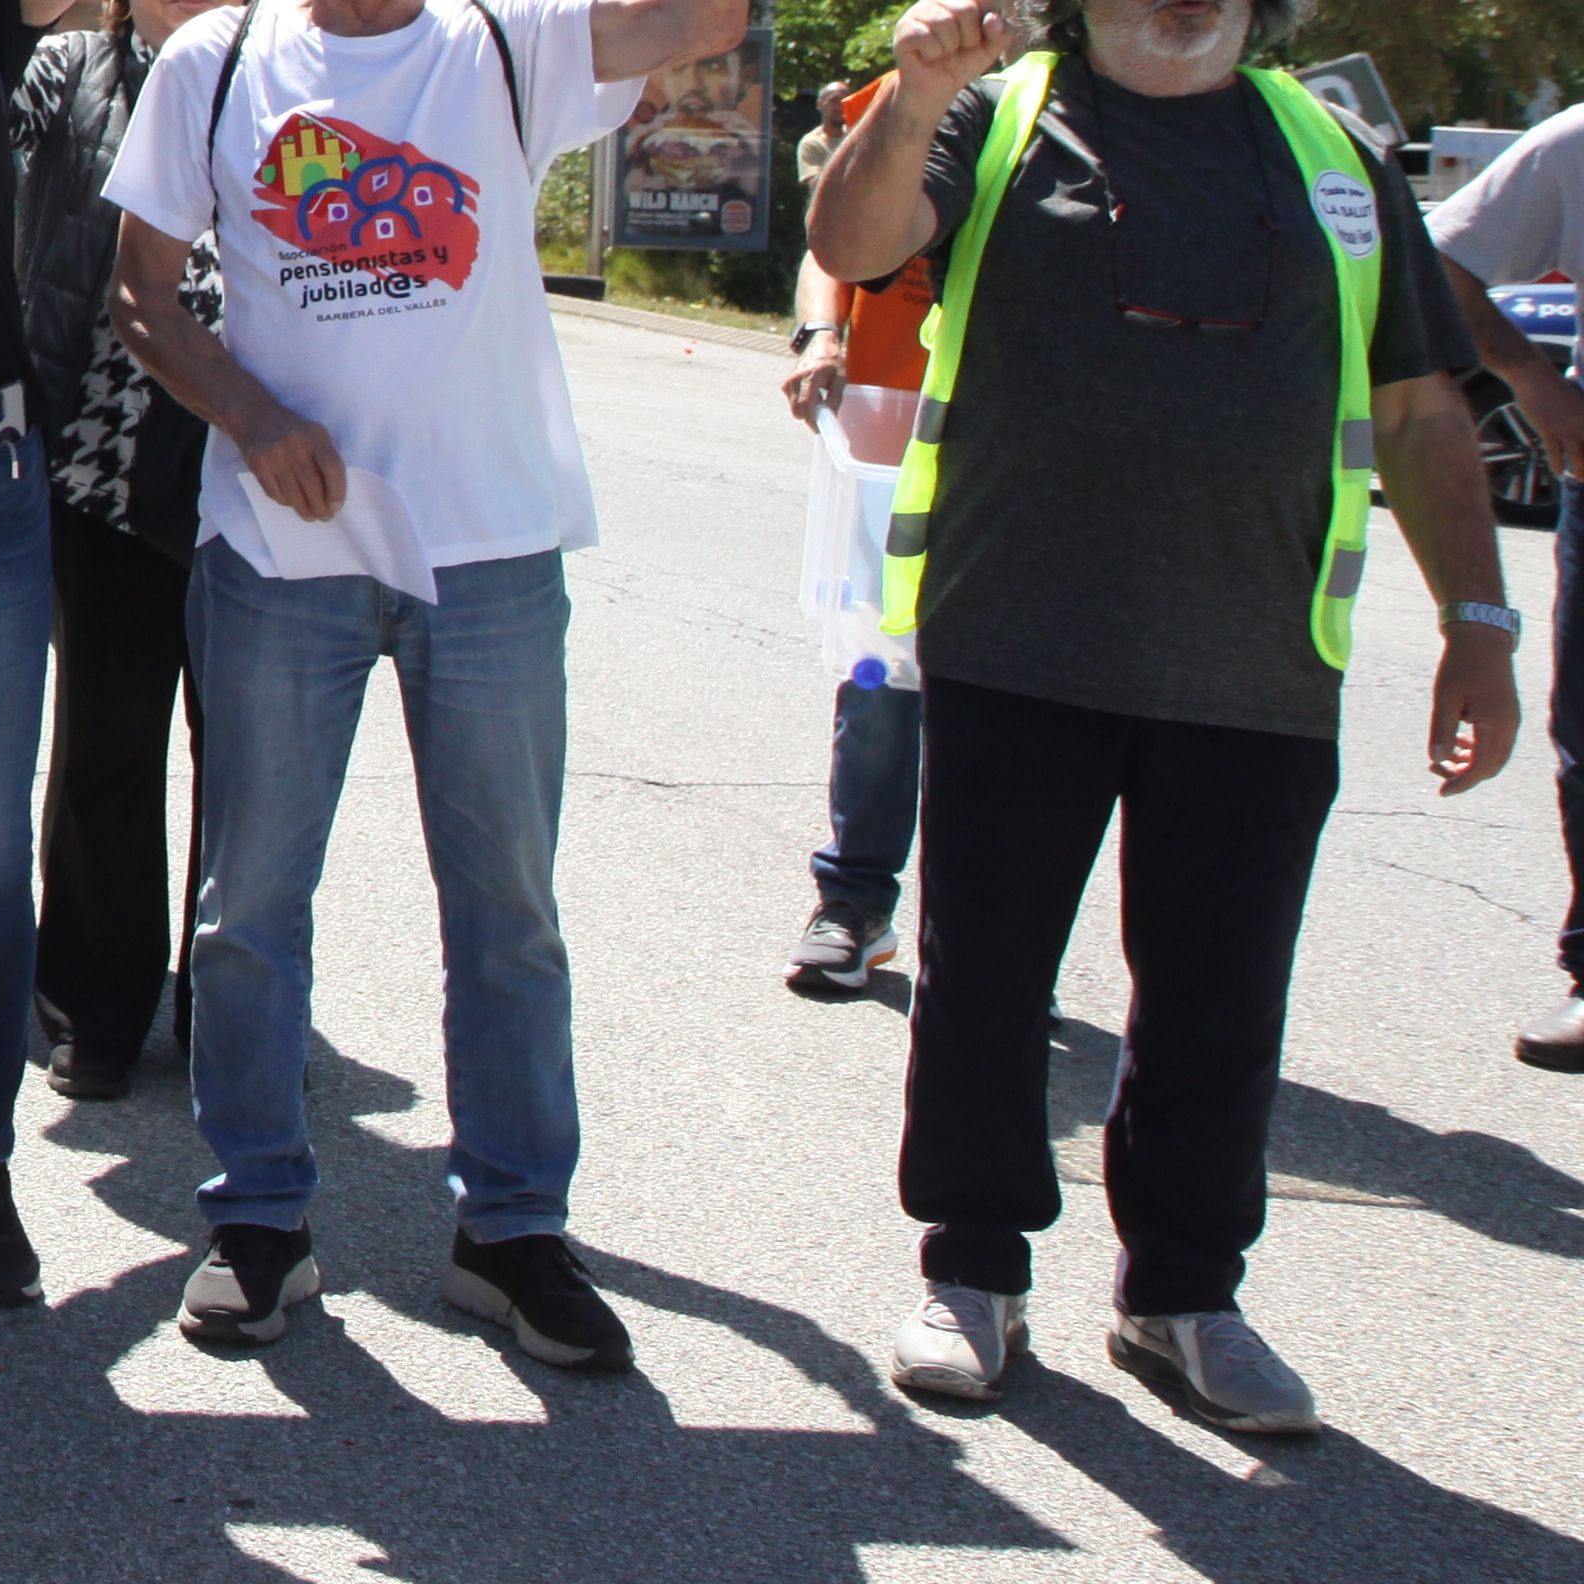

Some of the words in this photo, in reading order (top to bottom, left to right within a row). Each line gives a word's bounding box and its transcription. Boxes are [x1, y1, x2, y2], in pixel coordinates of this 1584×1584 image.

[280, 247, 427, 287] pensionistas
[433, 245, 448, 265] y
[300, 272, 426, 309] jubilad@s
[377, 305, 402, 316] DEL
